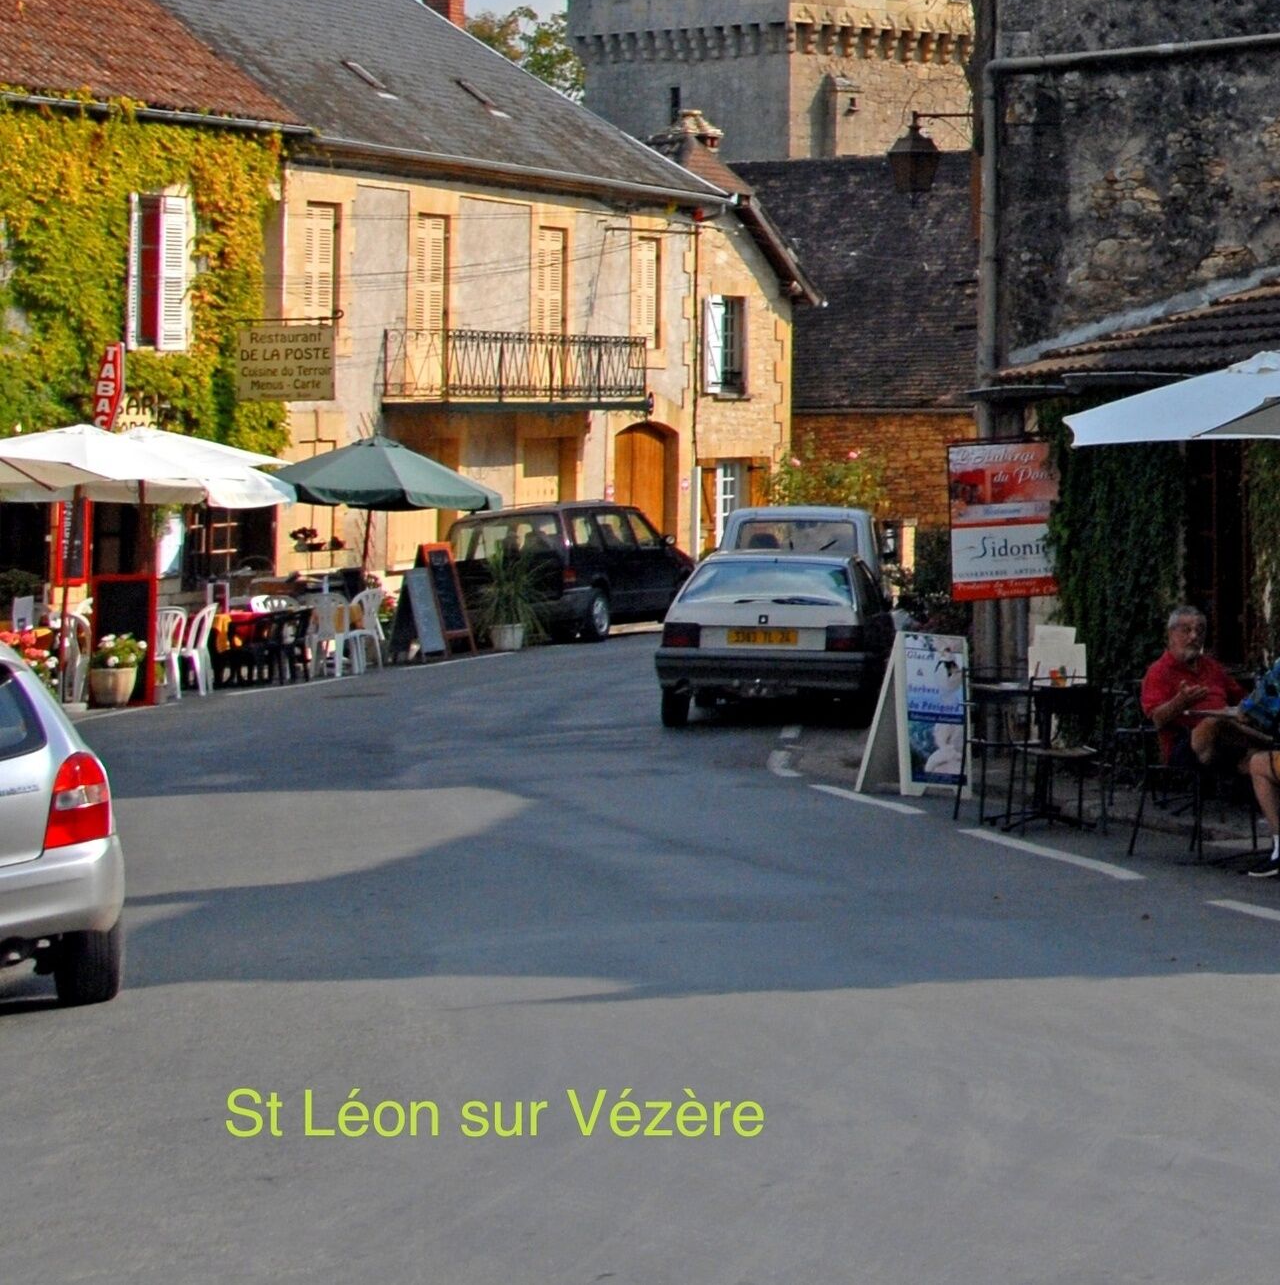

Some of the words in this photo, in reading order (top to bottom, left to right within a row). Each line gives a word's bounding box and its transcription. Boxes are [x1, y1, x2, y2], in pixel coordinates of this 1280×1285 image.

[250, 331, 322, 344] Restaurant
[240, 349, 258, 361] DE
[263, 349, 280, 361] LA
[284, 347, 331, 360] POSTE
[241, 366, 279, 378] Cuisine
[281, 366, 293, 376] du
[296, 364, 332, 376] Terroir
[94, 346, 119, 428] TABAC
[250, 379, 284, 391] Menus
[293, 378, 322, 390] Carte
[993, 470, 1009, 483] du
